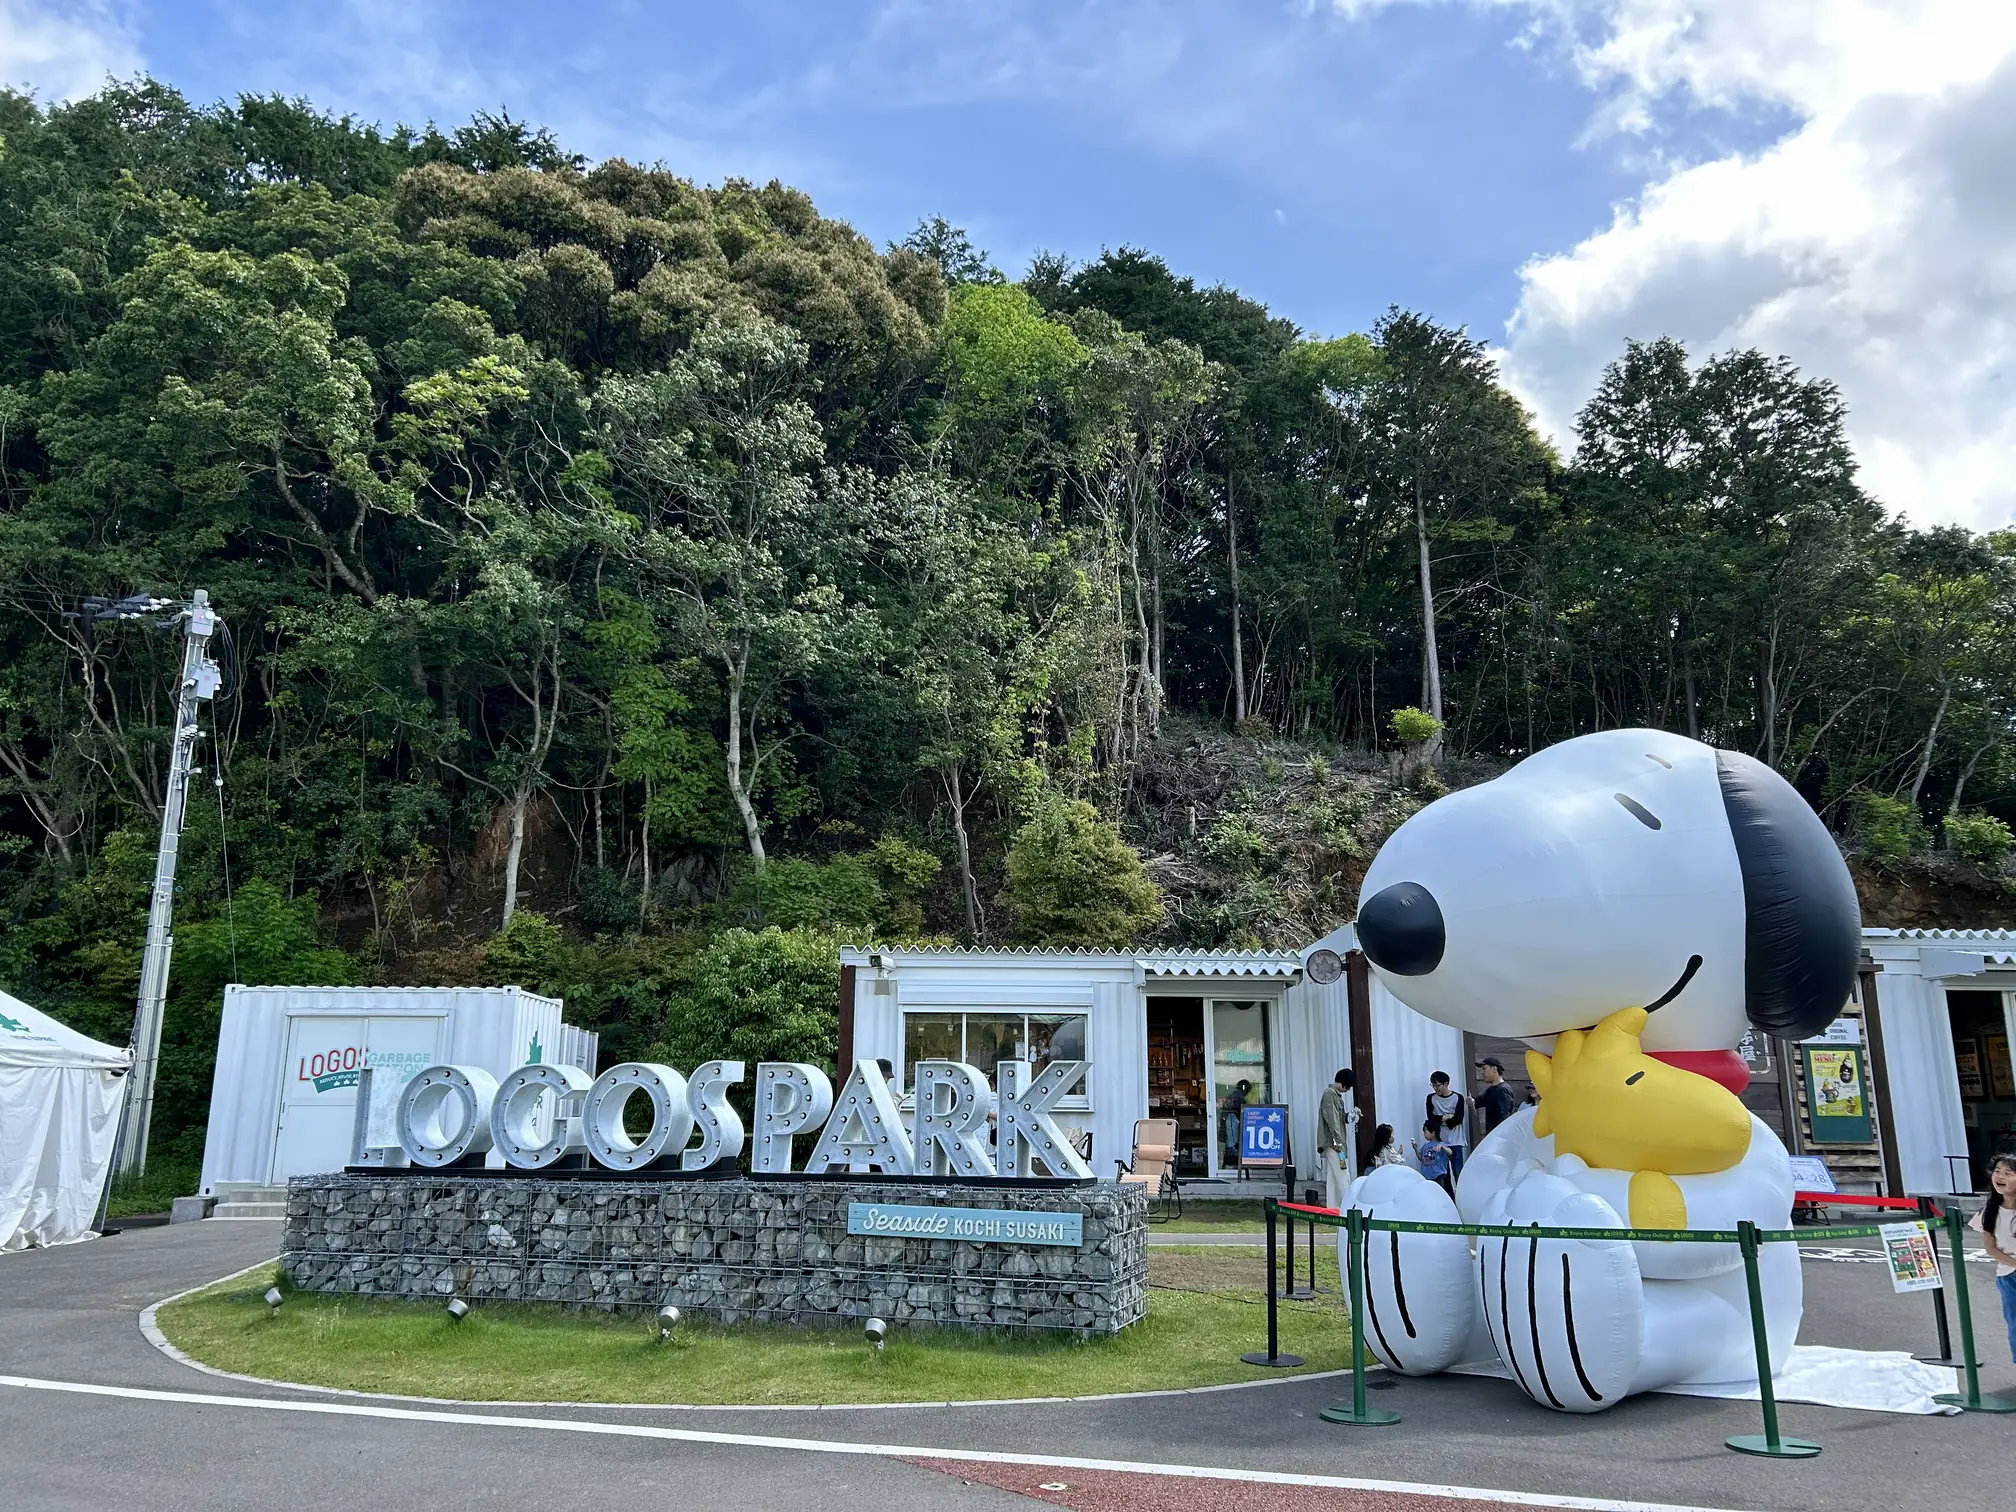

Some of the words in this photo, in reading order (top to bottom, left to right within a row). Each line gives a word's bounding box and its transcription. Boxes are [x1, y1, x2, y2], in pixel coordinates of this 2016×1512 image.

[368, 1052, 431, 1063] GARBAGE
[863, 1207, 949, 1234] Seaside
[954, 1218, 1001, 1238] KOCHI
[1006, 1220, 1064, 1240] SUSAKI
